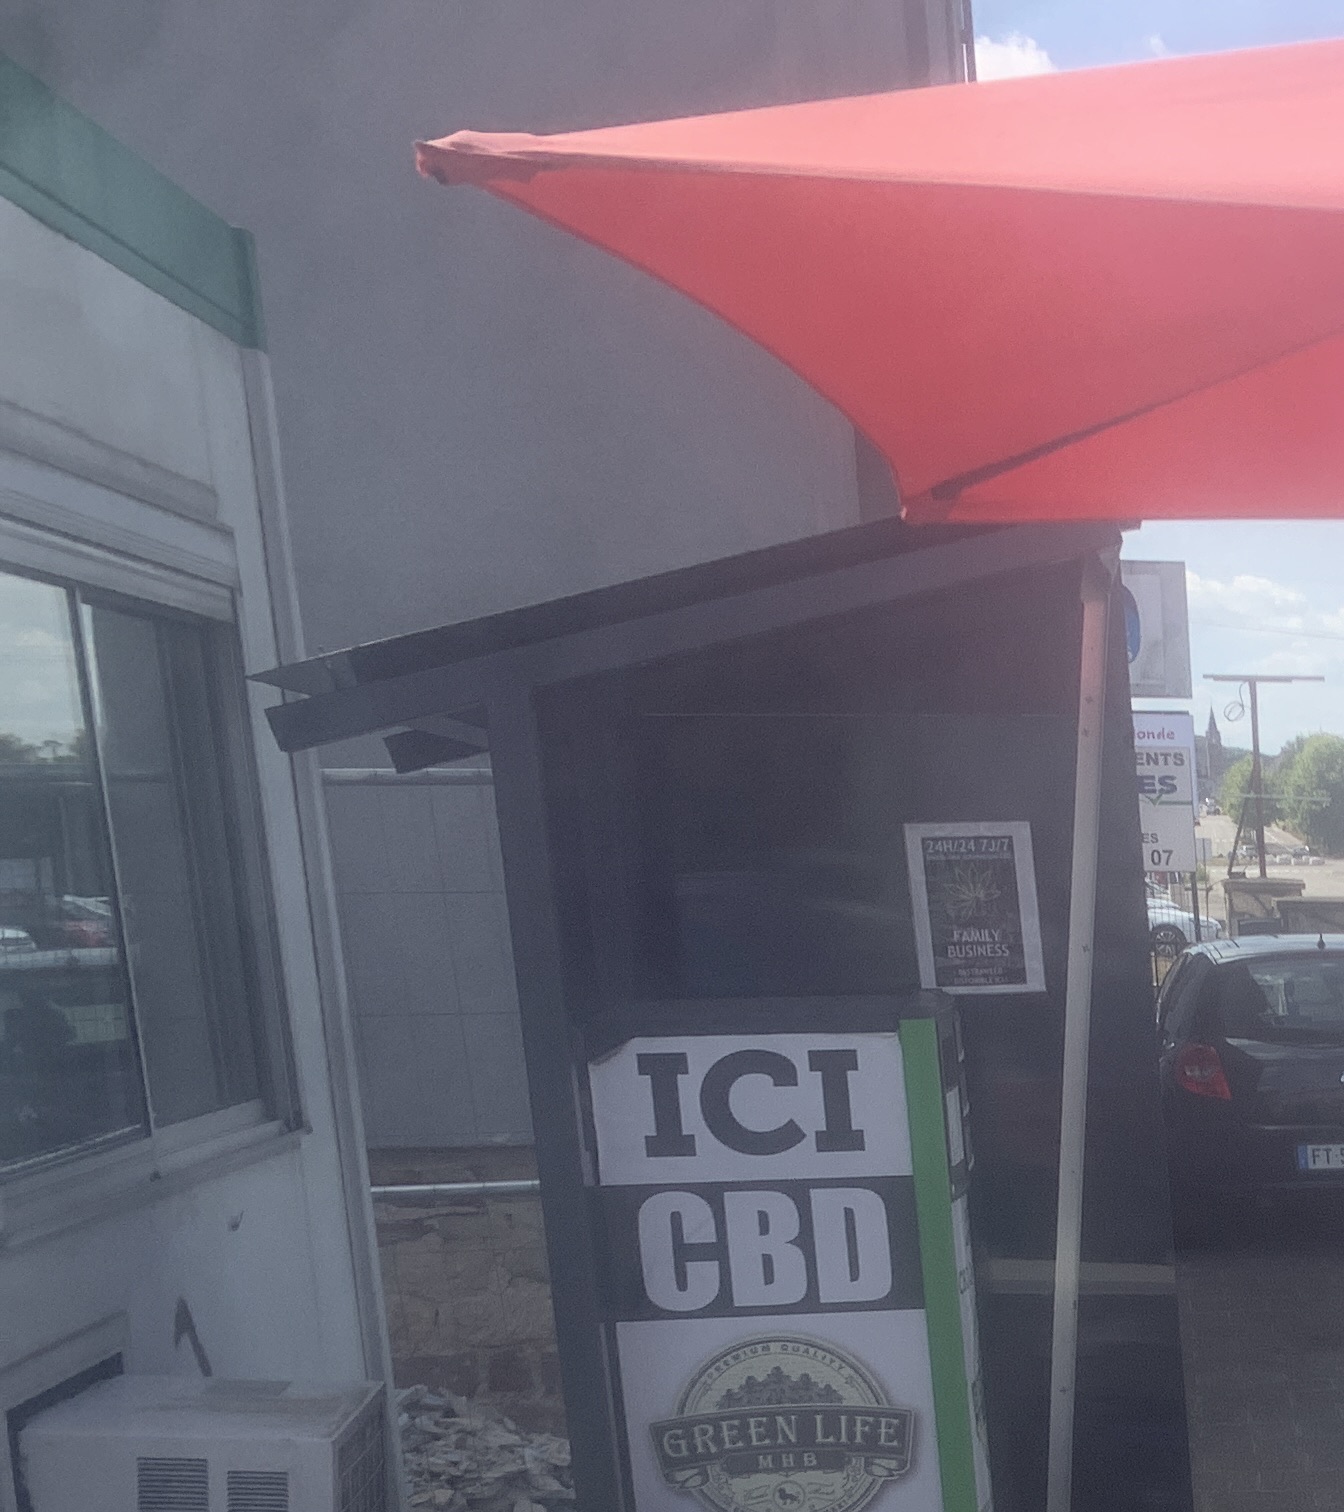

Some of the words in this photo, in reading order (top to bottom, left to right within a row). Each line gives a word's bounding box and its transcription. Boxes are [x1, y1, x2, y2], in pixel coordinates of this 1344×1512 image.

[925, 838, 976, 854] 24H/24
[980, 837, 1011, 852] 7J/7
[1151, 850, 1174, 866] 07
[953, 928, 1001, 943] FAMILY
[947, 943, 1010, 958] BUSINESS
[635, 1048, 867, 1158] ICI
[637, 1186, 893, 1312] CBD
[706, 1343, 771, 1380] PREMIUM
[780, 1344, 846, 1371] QUALITY
[662, 1415, 798, 1458] GREEN
[814, 1413, 901, 1447] LIFE
